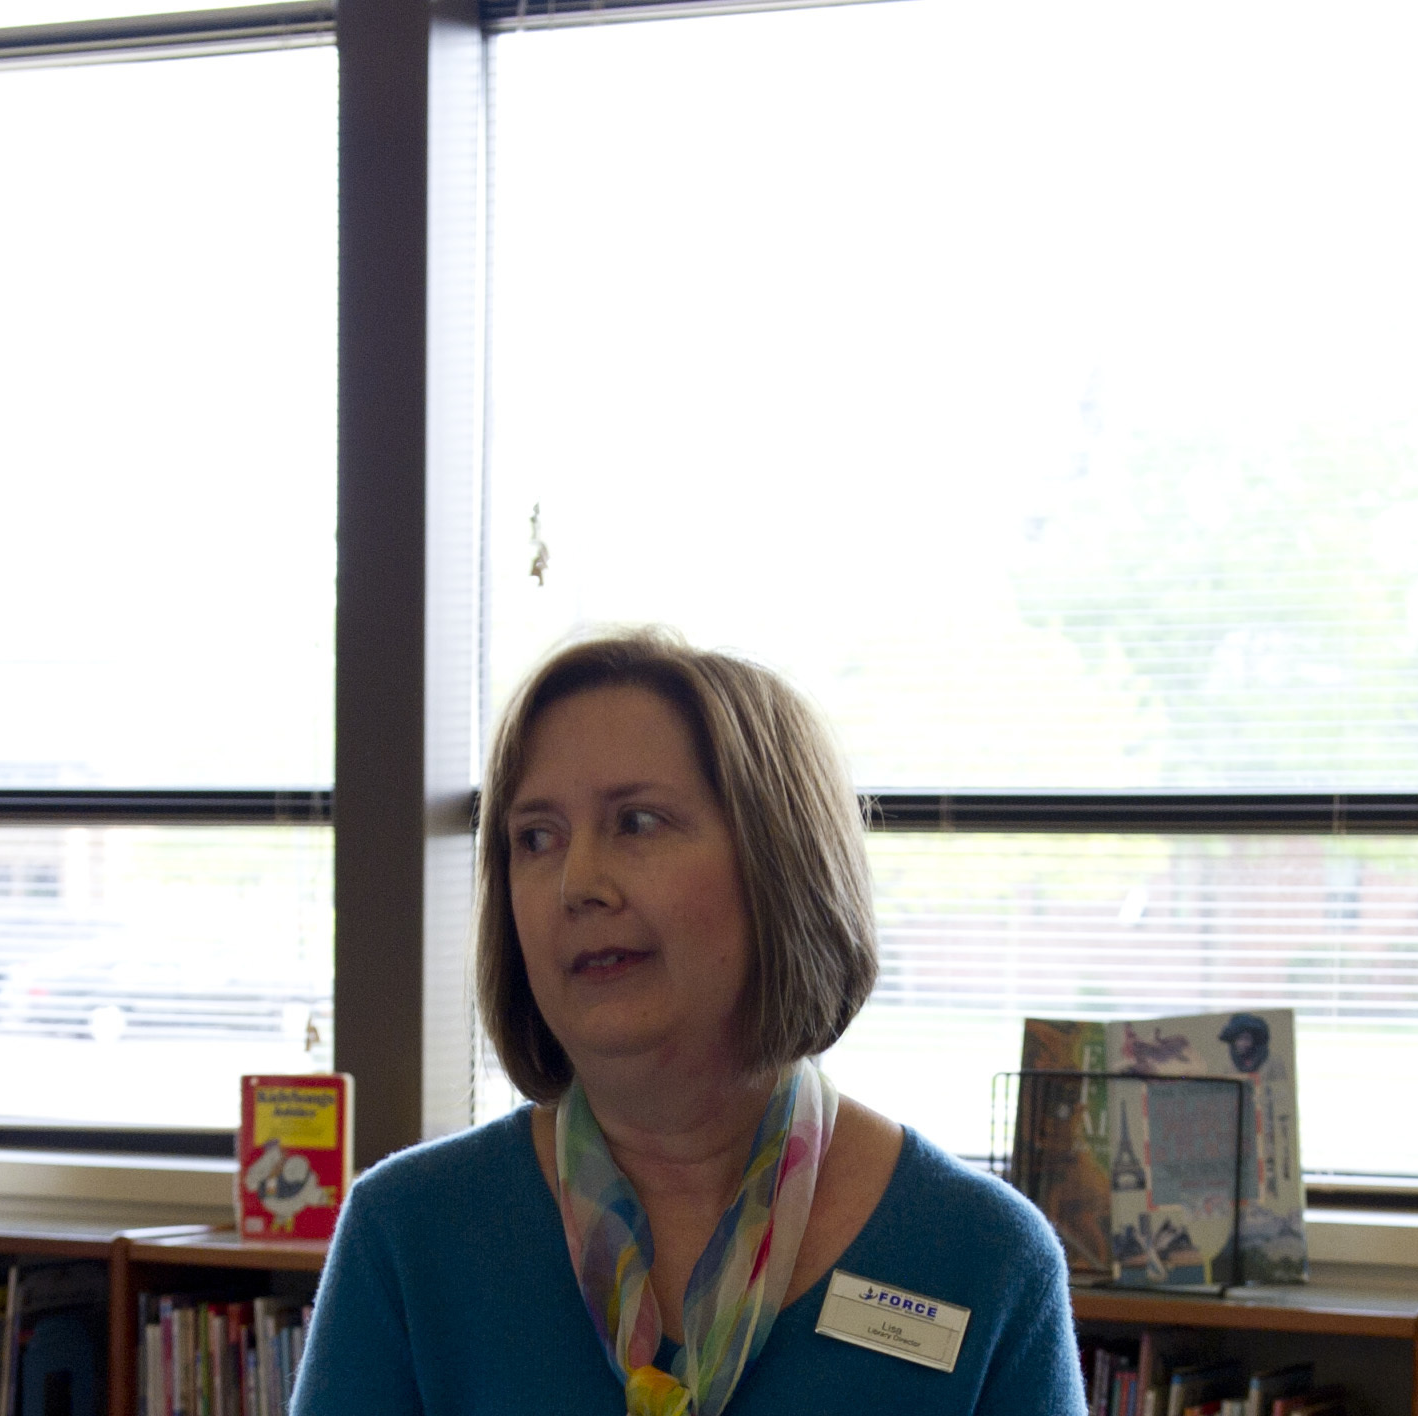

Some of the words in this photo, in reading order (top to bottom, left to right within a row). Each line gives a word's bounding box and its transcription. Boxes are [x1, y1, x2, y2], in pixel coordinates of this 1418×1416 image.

[878, 1292, 938, 1318] FORCE
[868, 1326, 891, 1340] Library
[893, 1334, 921, 1348] Director
[882, 1321, 902, 1335] Lisa
